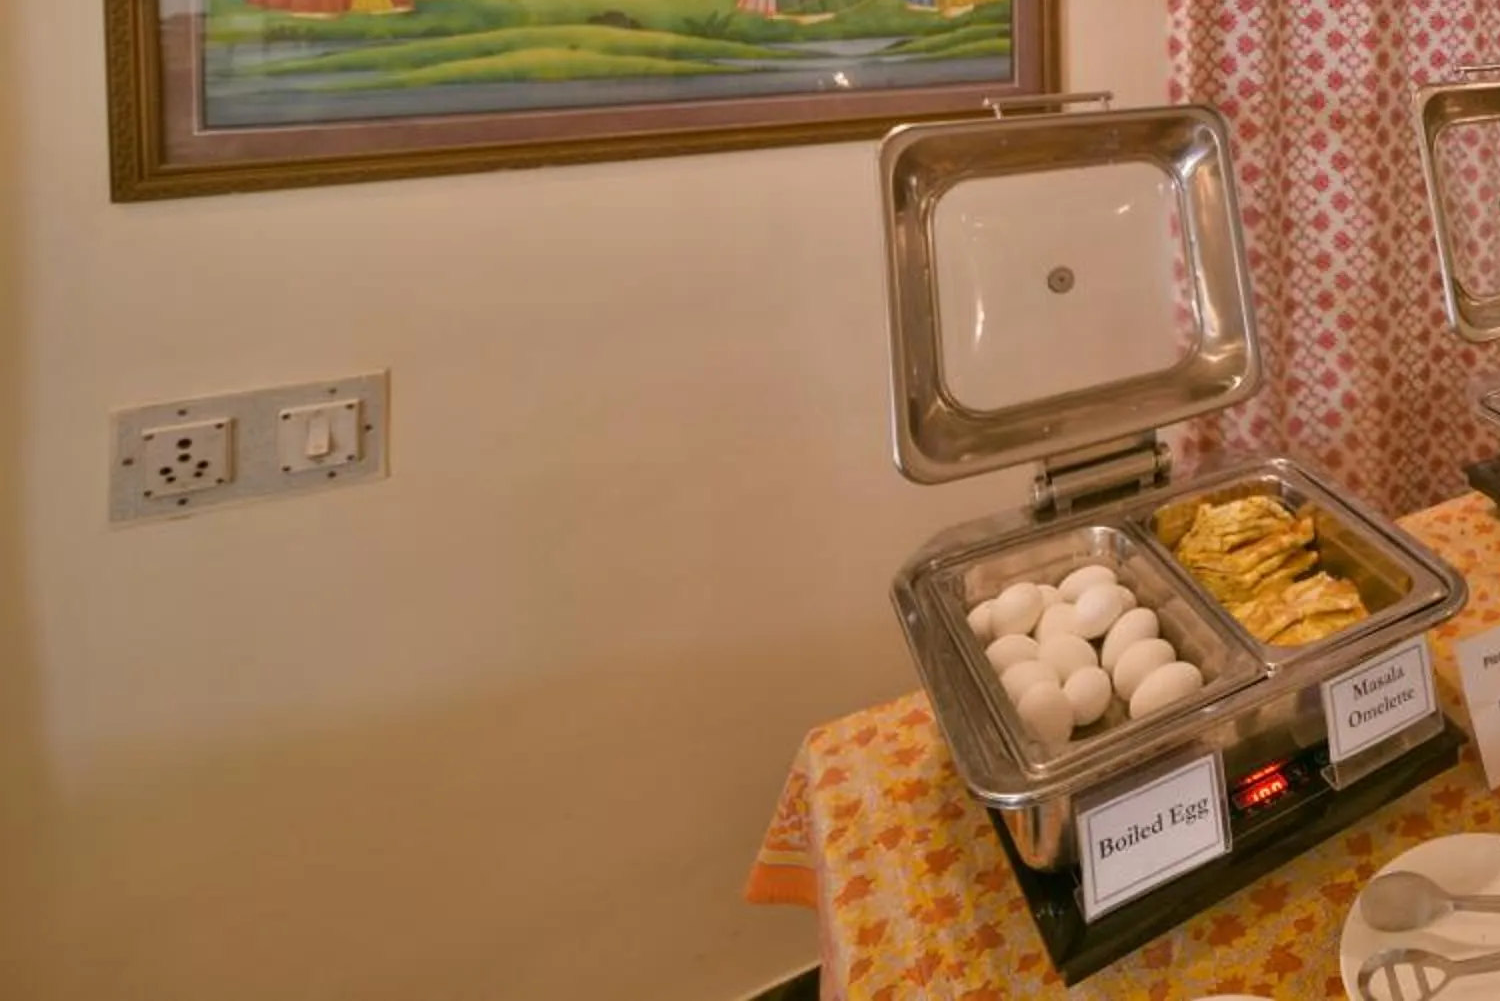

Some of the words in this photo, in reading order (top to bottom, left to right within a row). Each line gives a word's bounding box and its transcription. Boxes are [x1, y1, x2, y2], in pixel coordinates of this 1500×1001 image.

[1352, 665, 1405, 699] Masala
[1348, 687, 1415, 728] Omelette
[1099, 812, 1164, 860] Boiled
[1169, 796, 1210, 825] Egg
